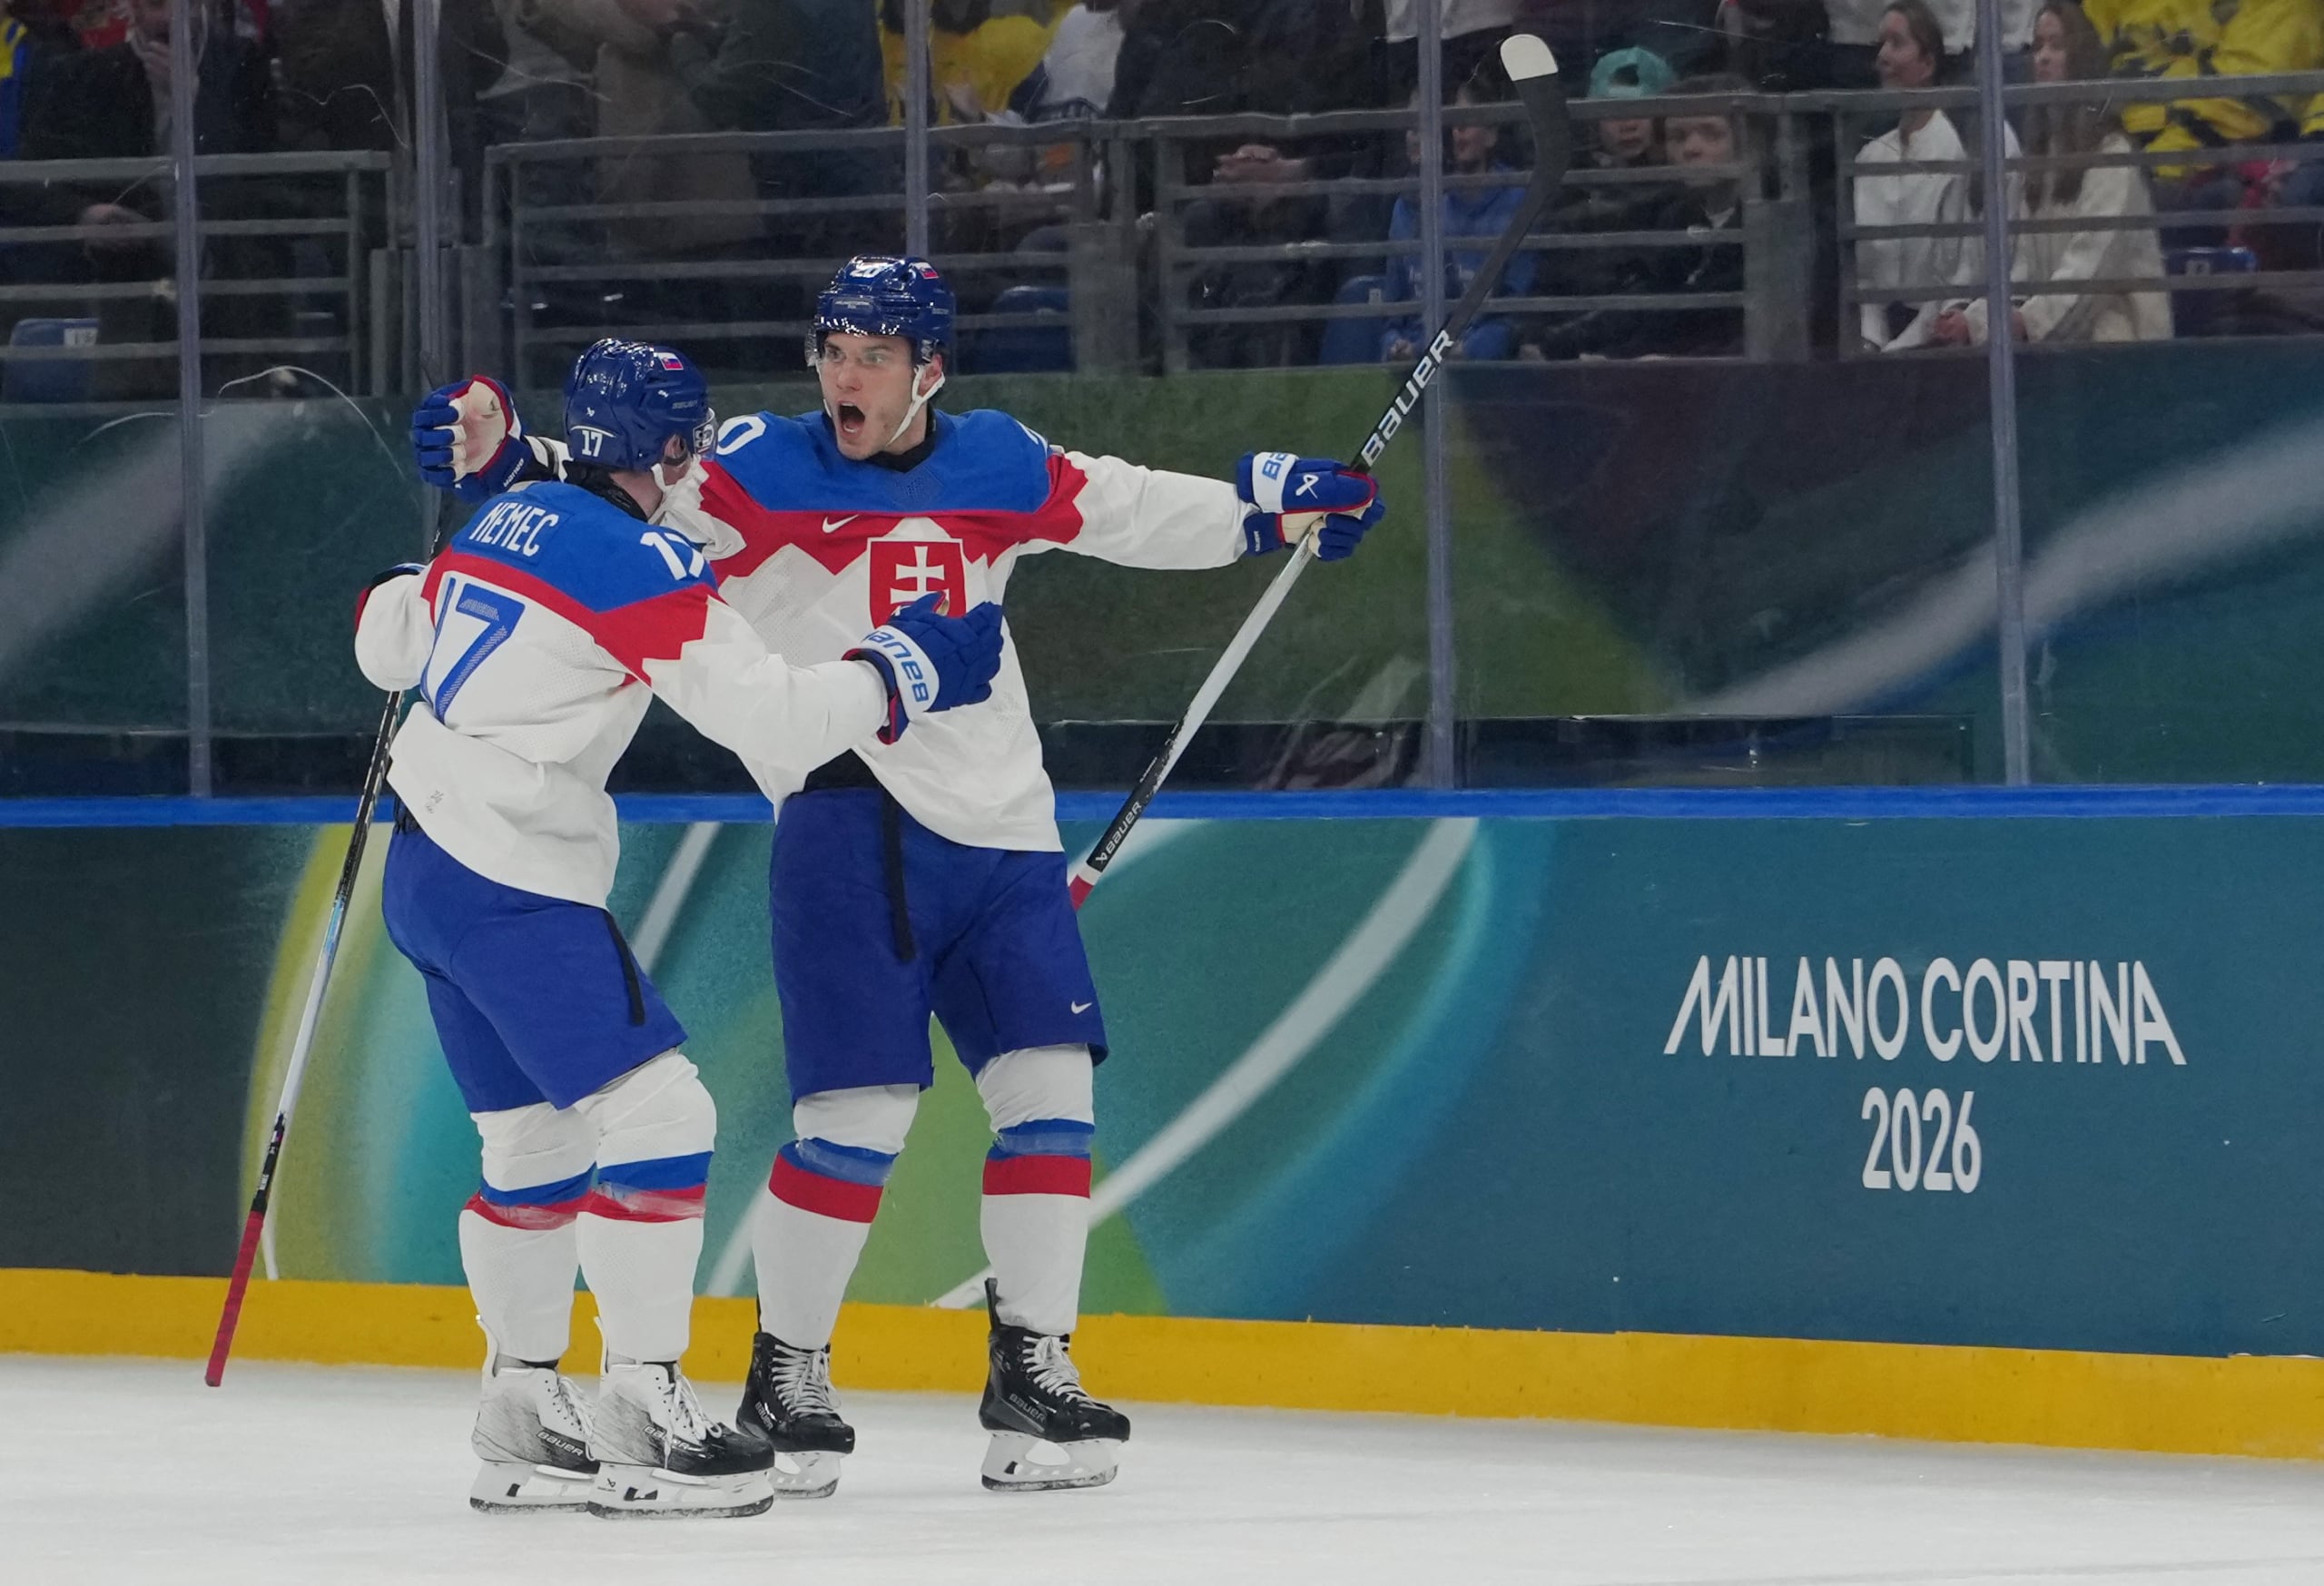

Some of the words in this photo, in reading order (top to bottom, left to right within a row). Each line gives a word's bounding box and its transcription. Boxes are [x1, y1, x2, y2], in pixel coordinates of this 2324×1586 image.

[1361, 329, 1453, 468] BAUER
[581, 429, 604, 458] 17
[468, 501, 560, 557] NEMEC
[862, 630, 930, 703] BAUE
[1106, 800, 1142, 855] BAUER
[1664, 954, 1909, 1061] MILANO
[1921, 957, 2187, 1066] CORTINA
[1861, 1087, 1982, 1195] 2026
[1008, 1393, 1047, 1423] BAUER
[536, 1430, 584, 1457] BAUER
[642, 1424, 691, 1451] BAER
